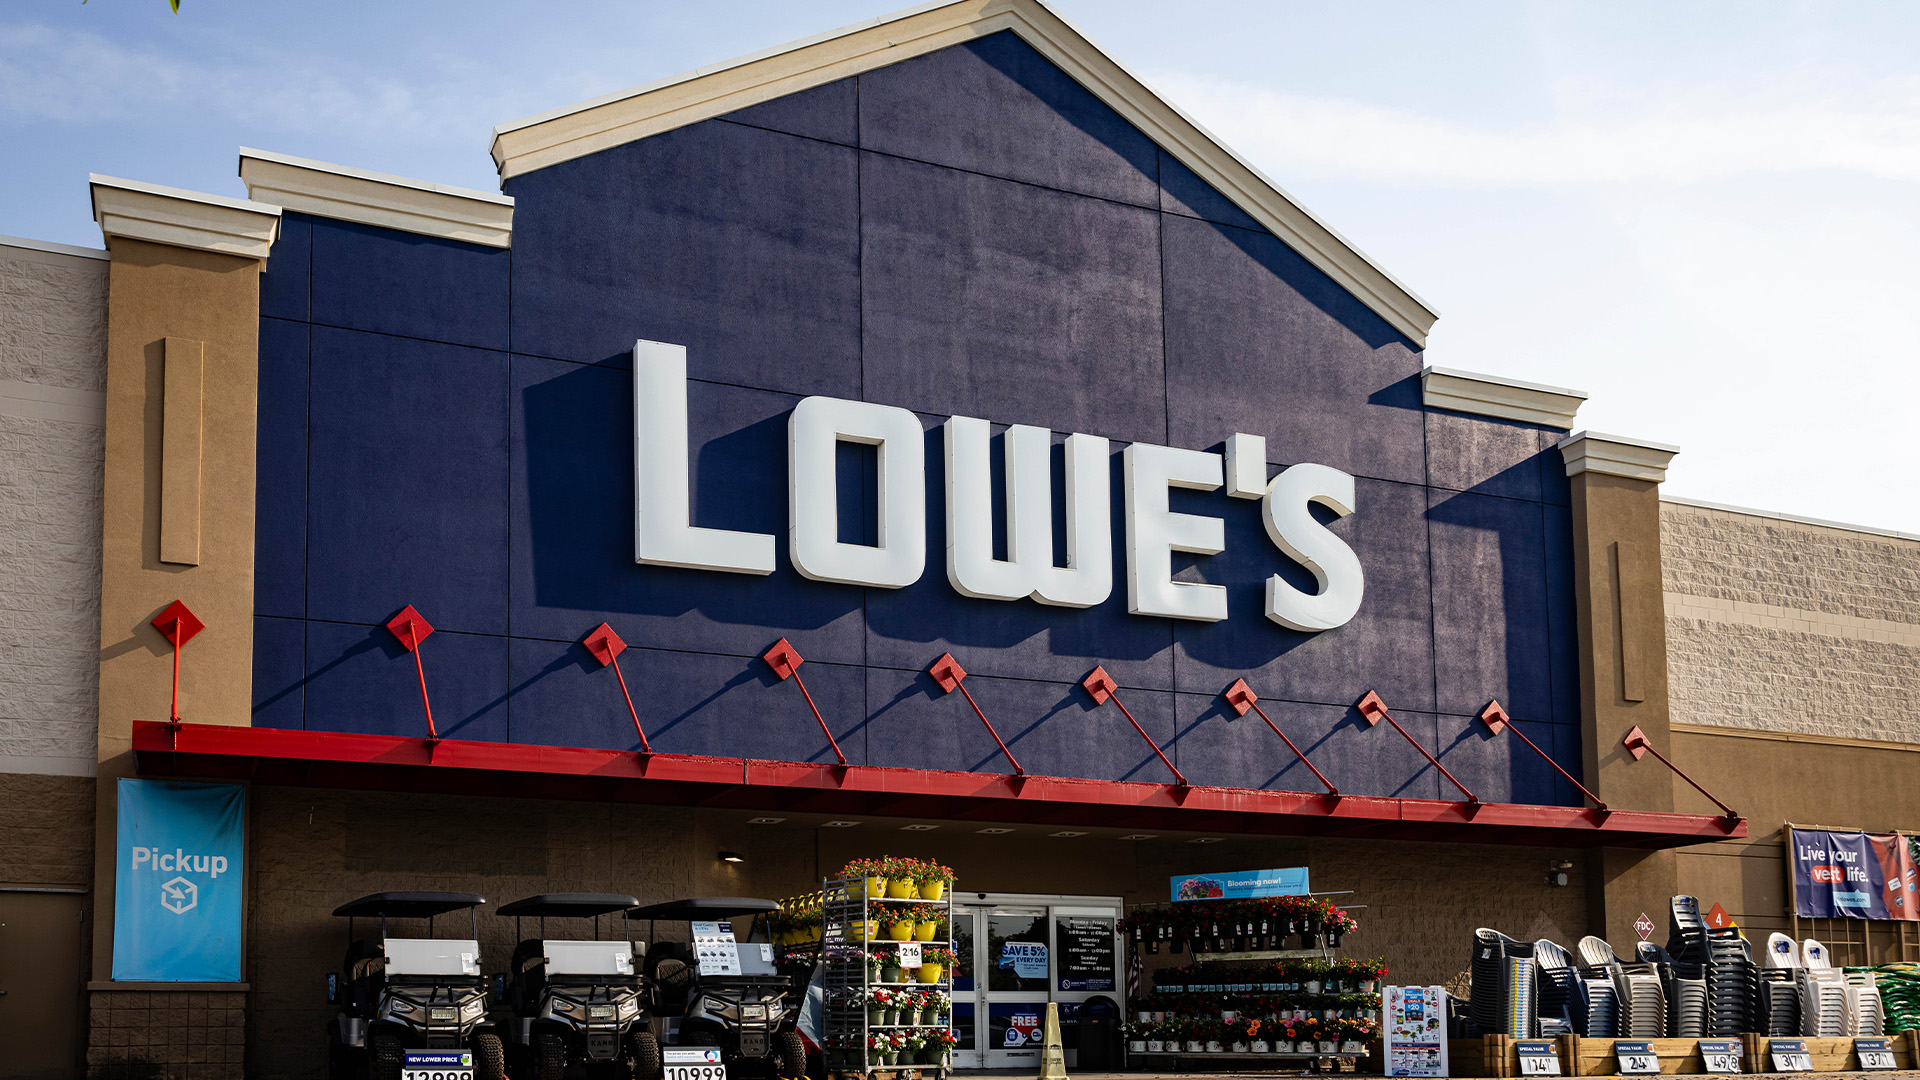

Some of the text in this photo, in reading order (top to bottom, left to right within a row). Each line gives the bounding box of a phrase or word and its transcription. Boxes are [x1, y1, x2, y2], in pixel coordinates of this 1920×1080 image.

[1800, 845, 1858, 865] Live your
[131, 846, 228, 878] Pickup
[1813, 867, 1869, 883] vest life.
[1227, 877, 1282, 887] Blooming now!
[1636, 921, 1651, 931] FDC
[1715, 912, 1723, 927] 4
[1001, 945, 1045, 957] SAVE 5%
[1011, 1015, 1038, 1027] FREE
